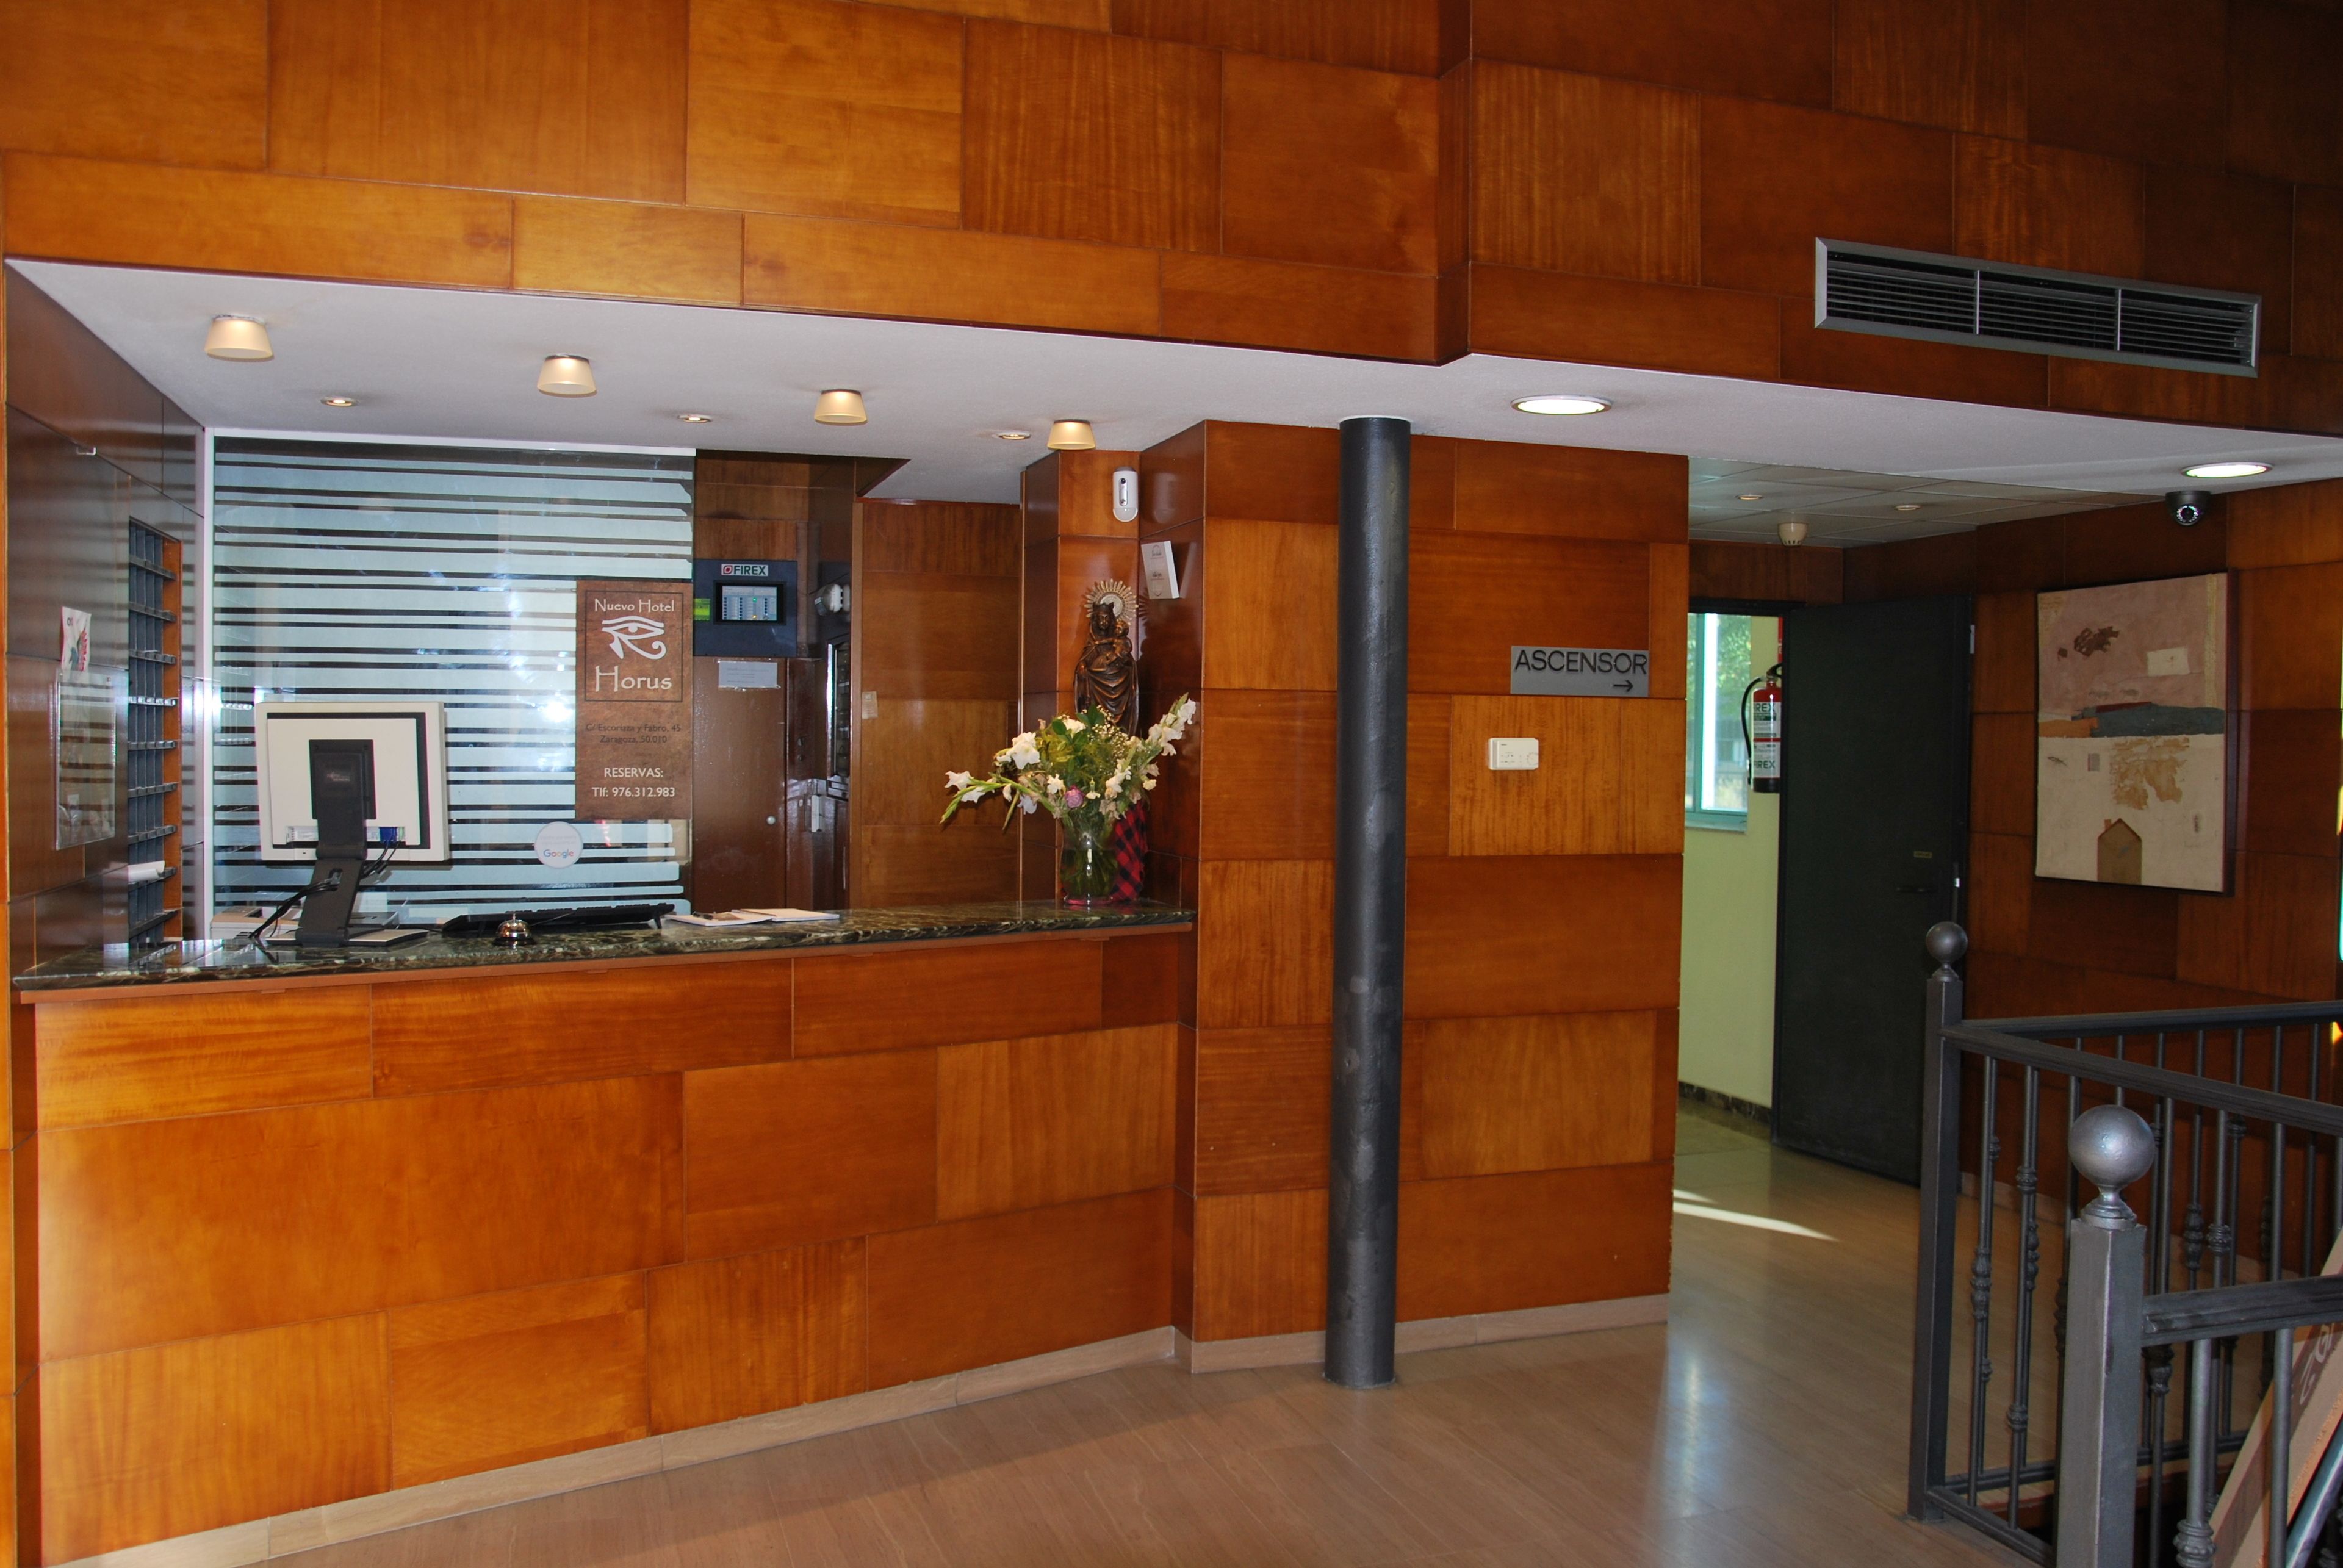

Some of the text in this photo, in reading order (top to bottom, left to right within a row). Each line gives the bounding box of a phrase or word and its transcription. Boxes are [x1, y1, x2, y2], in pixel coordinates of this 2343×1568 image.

[734, 566, 766, 575] FIREX
[594, 598, 674, 612] Nuevo Hotel
[1515, 649, 1647, 674] ASCENSOR
[595, 665, 672, 692] Horus
[1754, 703, 1775, 712] REX
[604, 768, 664, 777] RESERVAS:
[592, 787, 675, 797] Tlf: 976.312.983
[544, 849, 574, 858] Google
